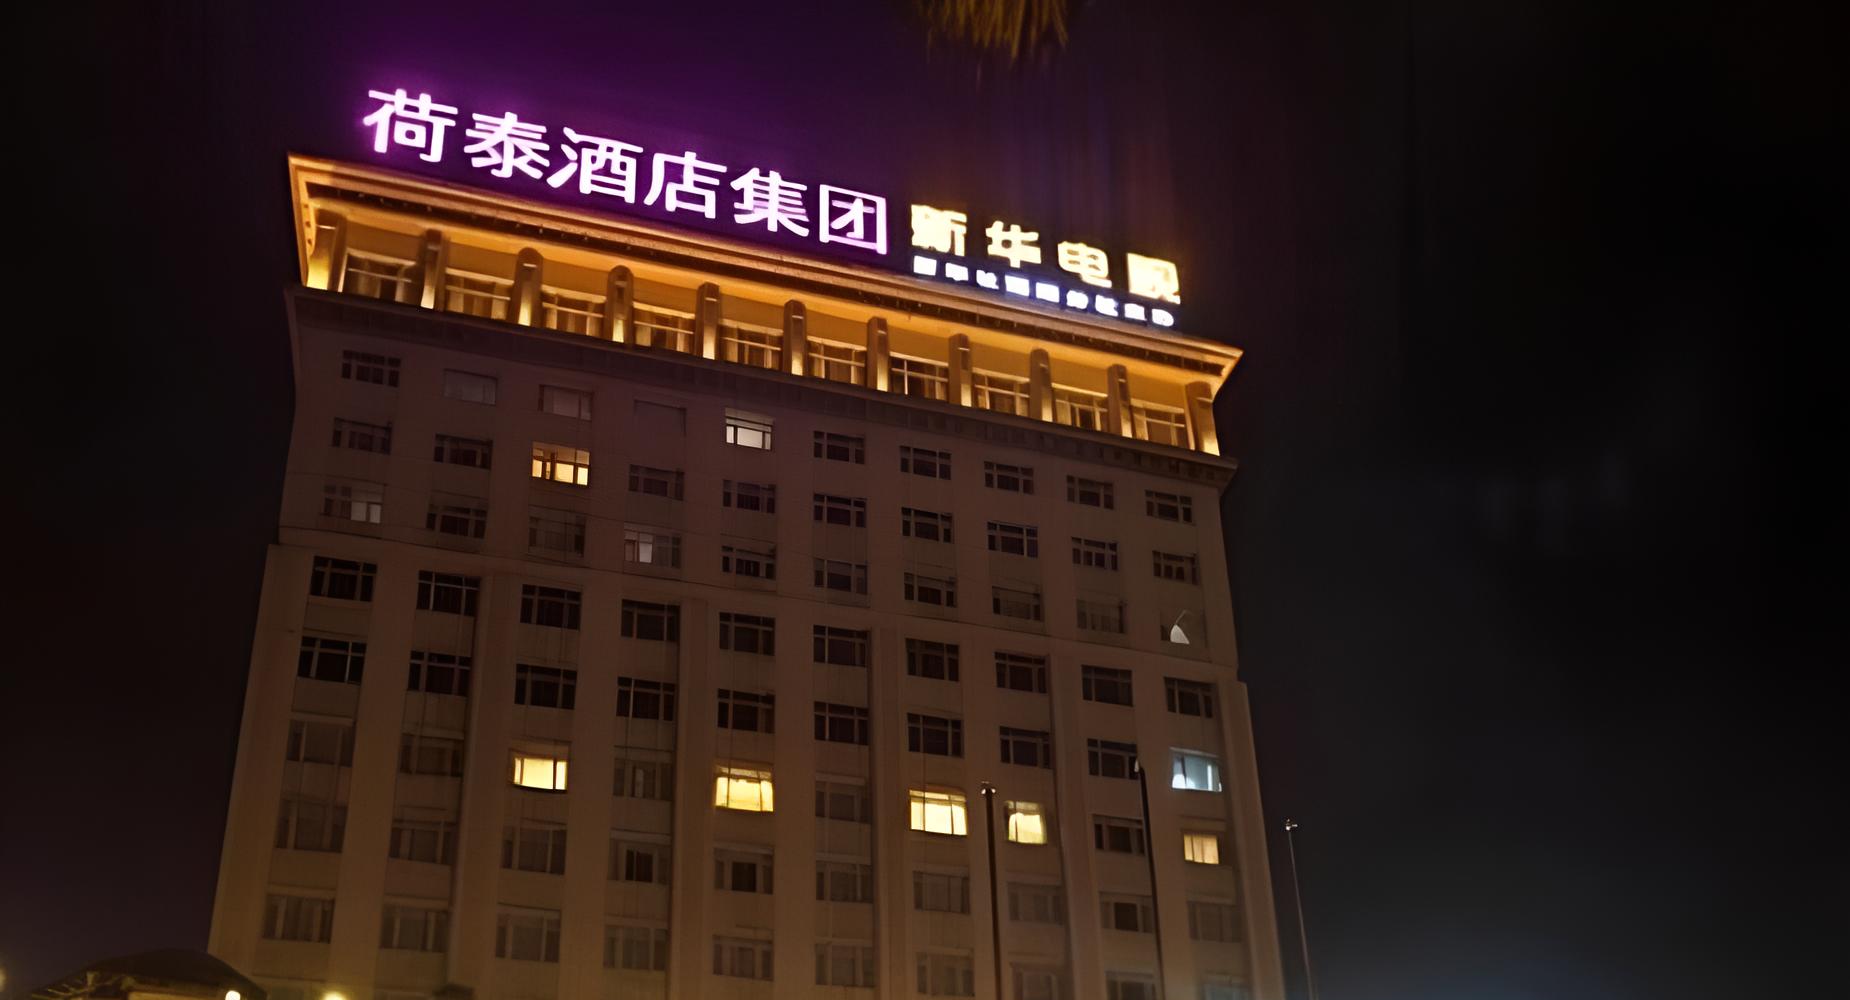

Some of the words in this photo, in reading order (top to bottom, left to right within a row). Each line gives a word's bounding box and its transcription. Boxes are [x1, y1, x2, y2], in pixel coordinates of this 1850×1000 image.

[363, 88, 888, 255] 荷泰酒店集团
